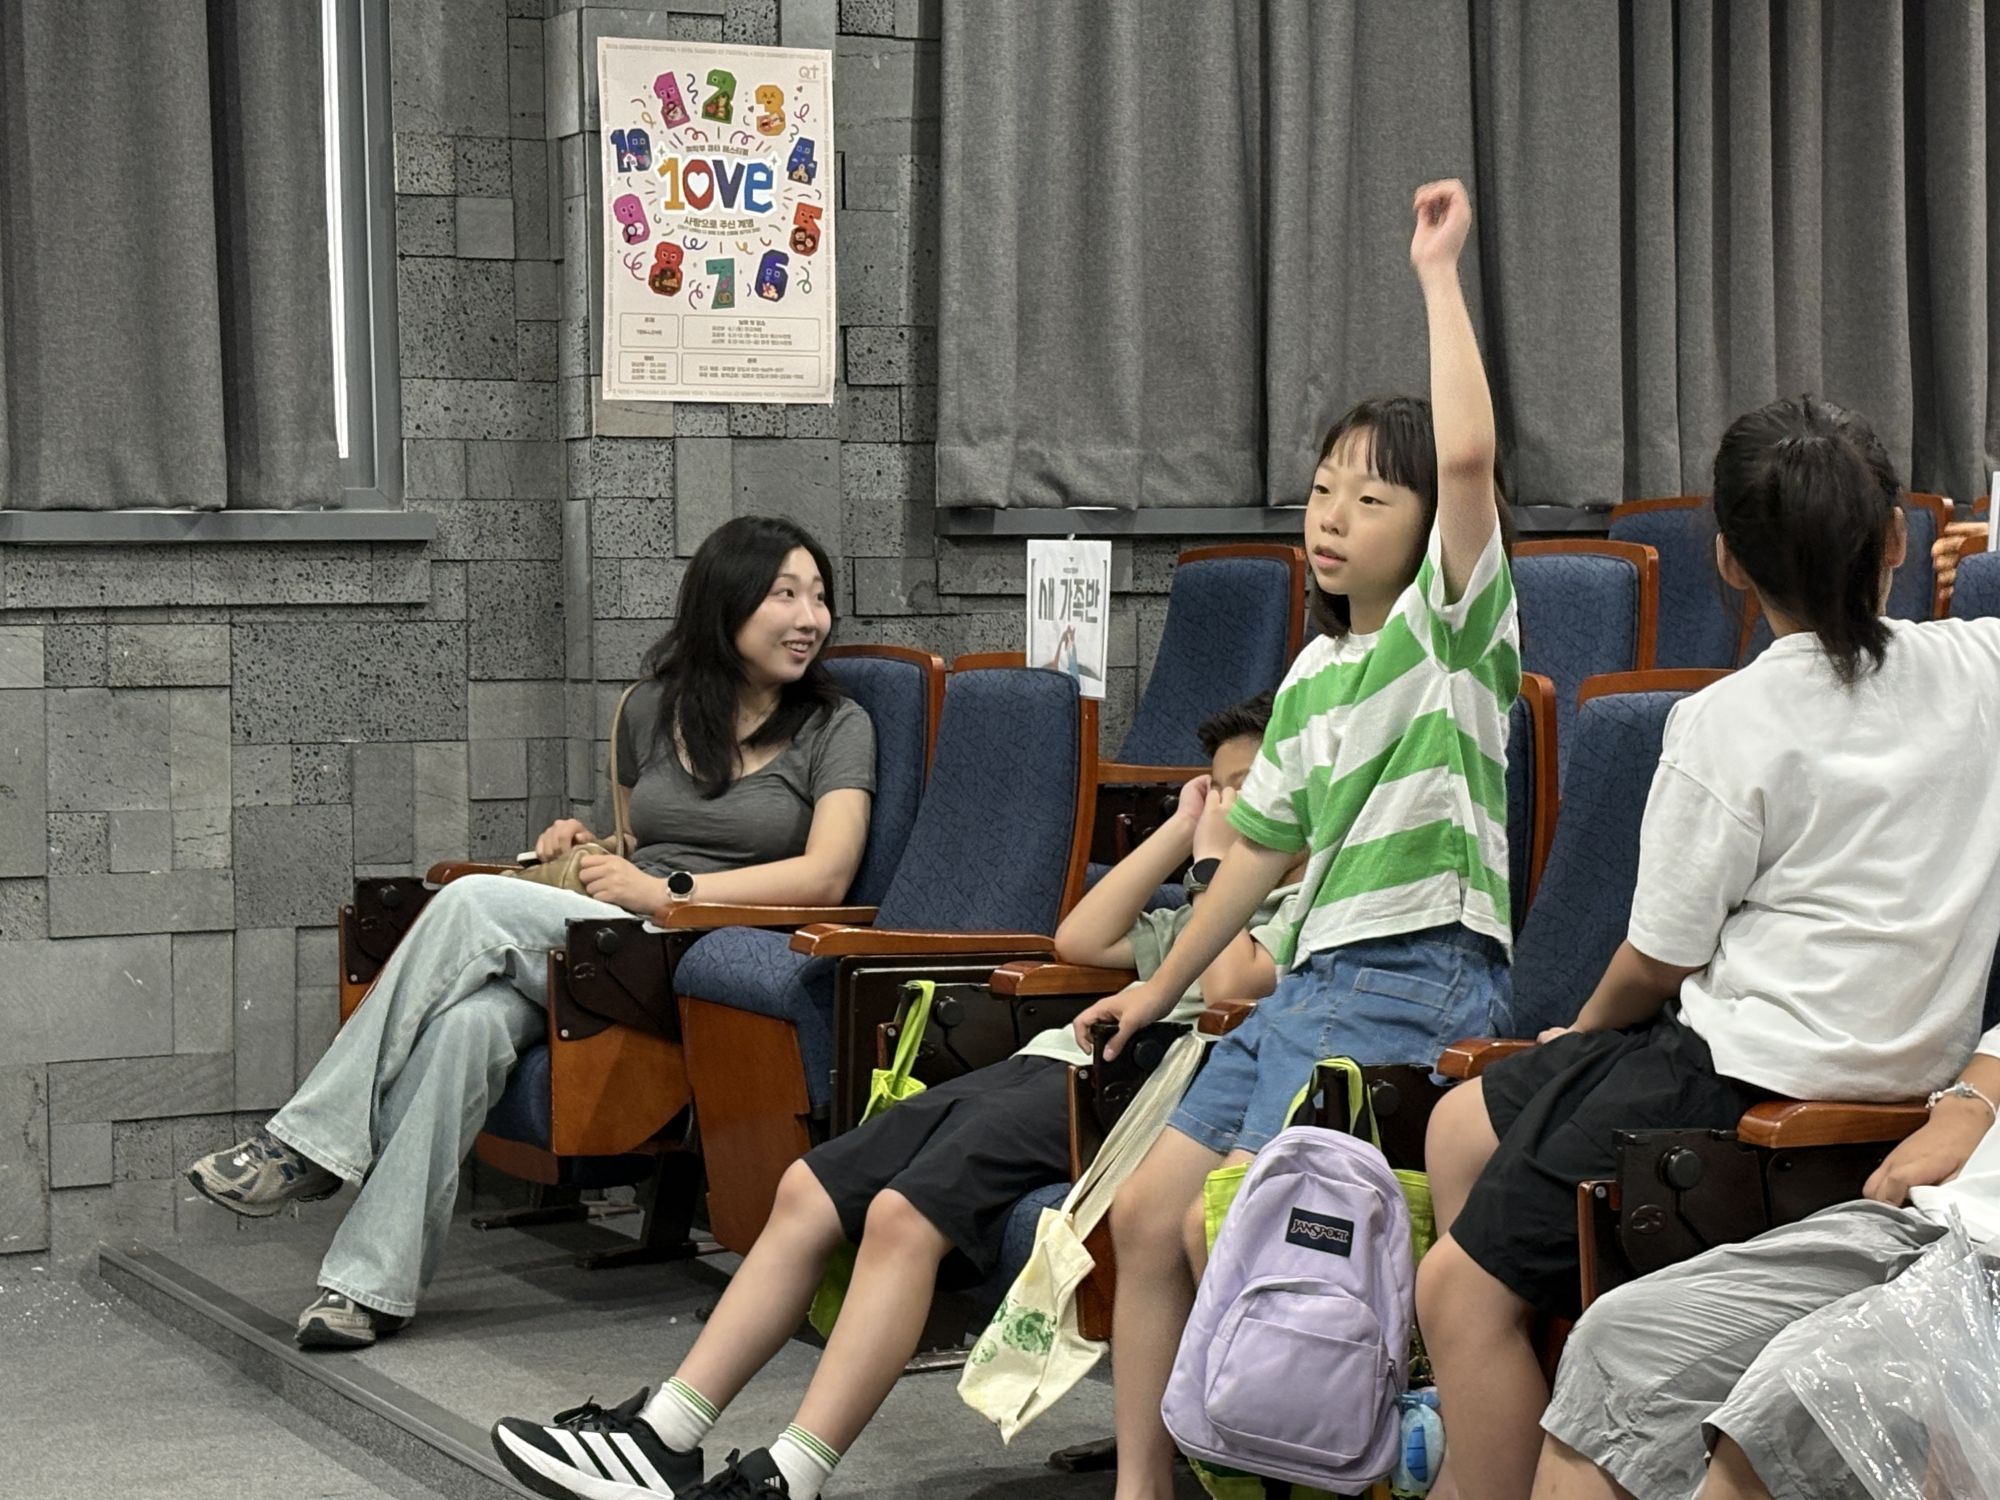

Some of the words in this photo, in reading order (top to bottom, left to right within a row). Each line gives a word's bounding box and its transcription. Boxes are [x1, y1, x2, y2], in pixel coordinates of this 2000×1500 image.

[683, 216, 718, 229] 사랑으로
[719, 219, 736, 229] 주신
[1038, 577, 1055, 621] 새
[1059, 578, 1100, 624] 가족반
[1291, 1219, 1349, 1243] JANSPORT
